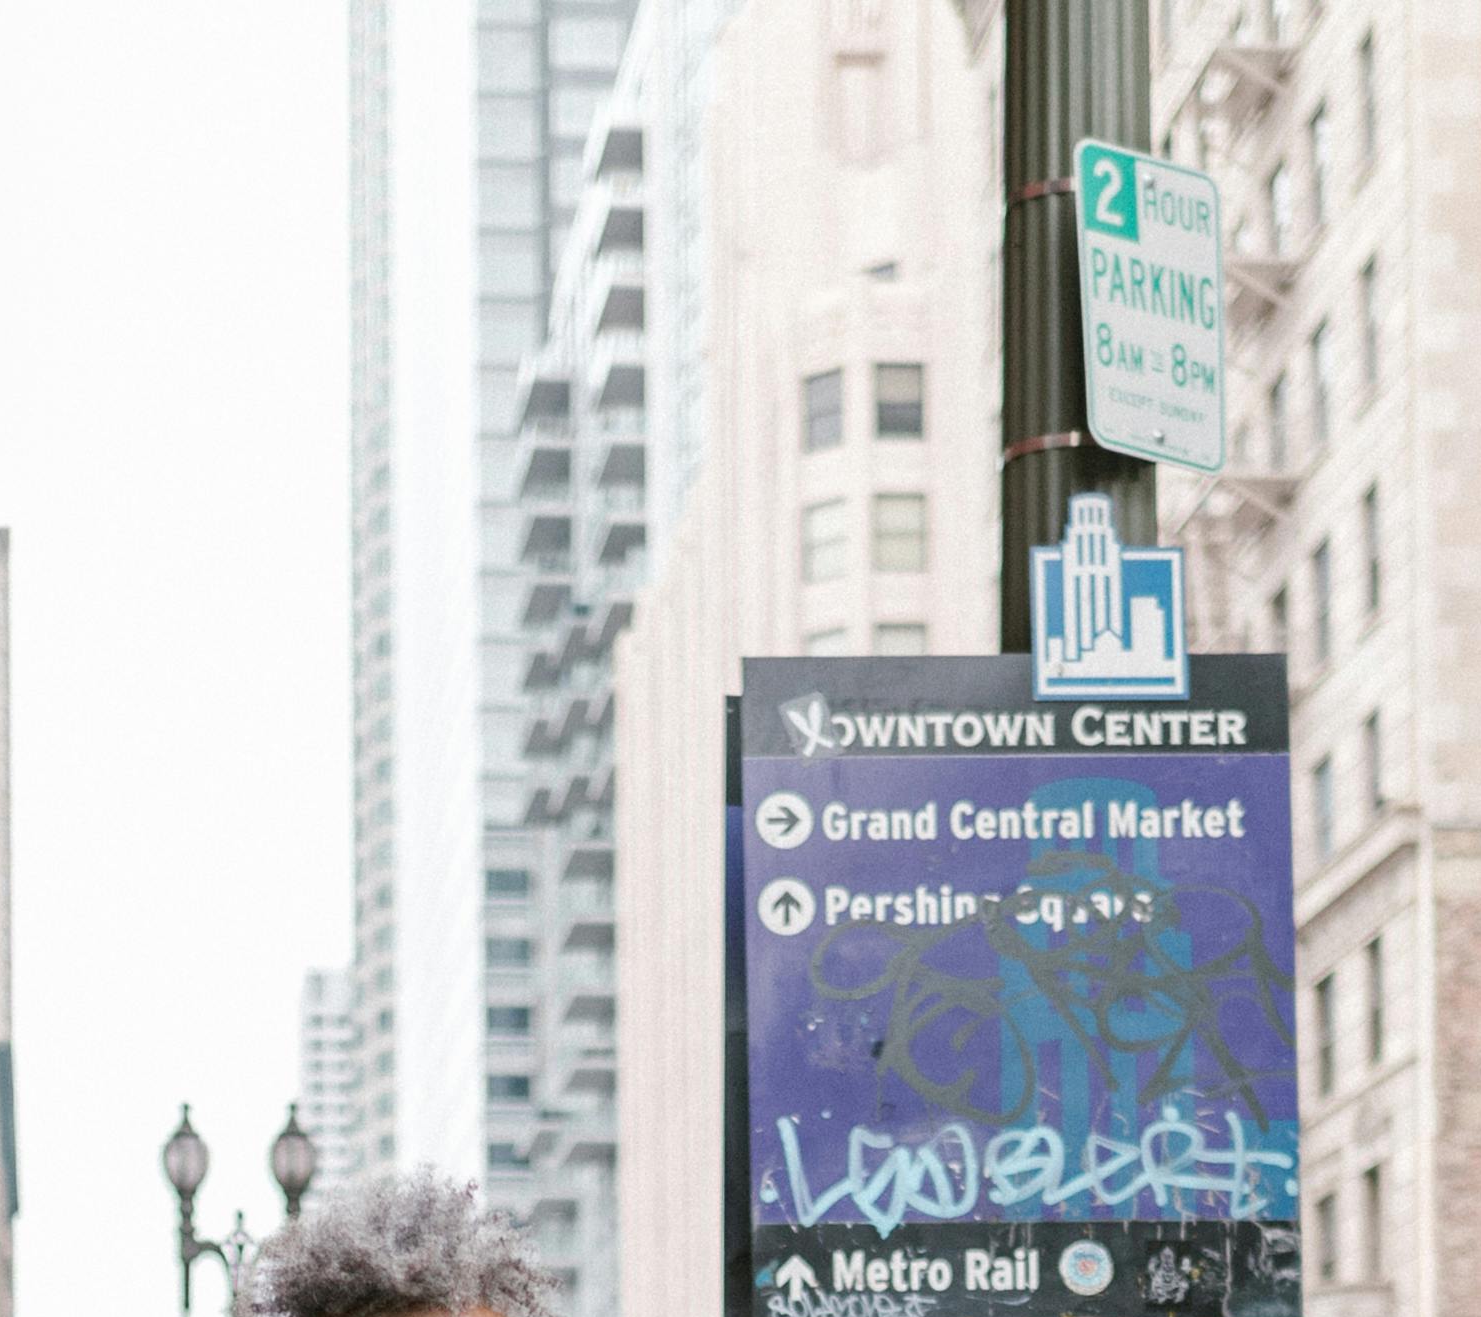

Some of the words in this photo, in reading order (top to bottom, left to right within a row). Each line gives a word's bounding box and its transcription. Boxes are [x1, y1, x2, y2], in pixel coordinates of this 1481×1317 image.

[1092, 157, 1126, 228] 2
[1142, 187, 1212, 237] HOUR
[1091, 247, 1216, 331] PARKING
[830, 711, 1055, 749] OWNTOWN
[1071, 704, 1248, 747] CENTER
[822, 802, 937, 842] Grand
[950, 801, 1094, 840] Central
[1108, 798, 1246, 839] Market
[824, 884, 1001, 926] Pershin
[832, 1250, 952, 1292] Metro
[965, 1248, 1039, 1291] Rail
